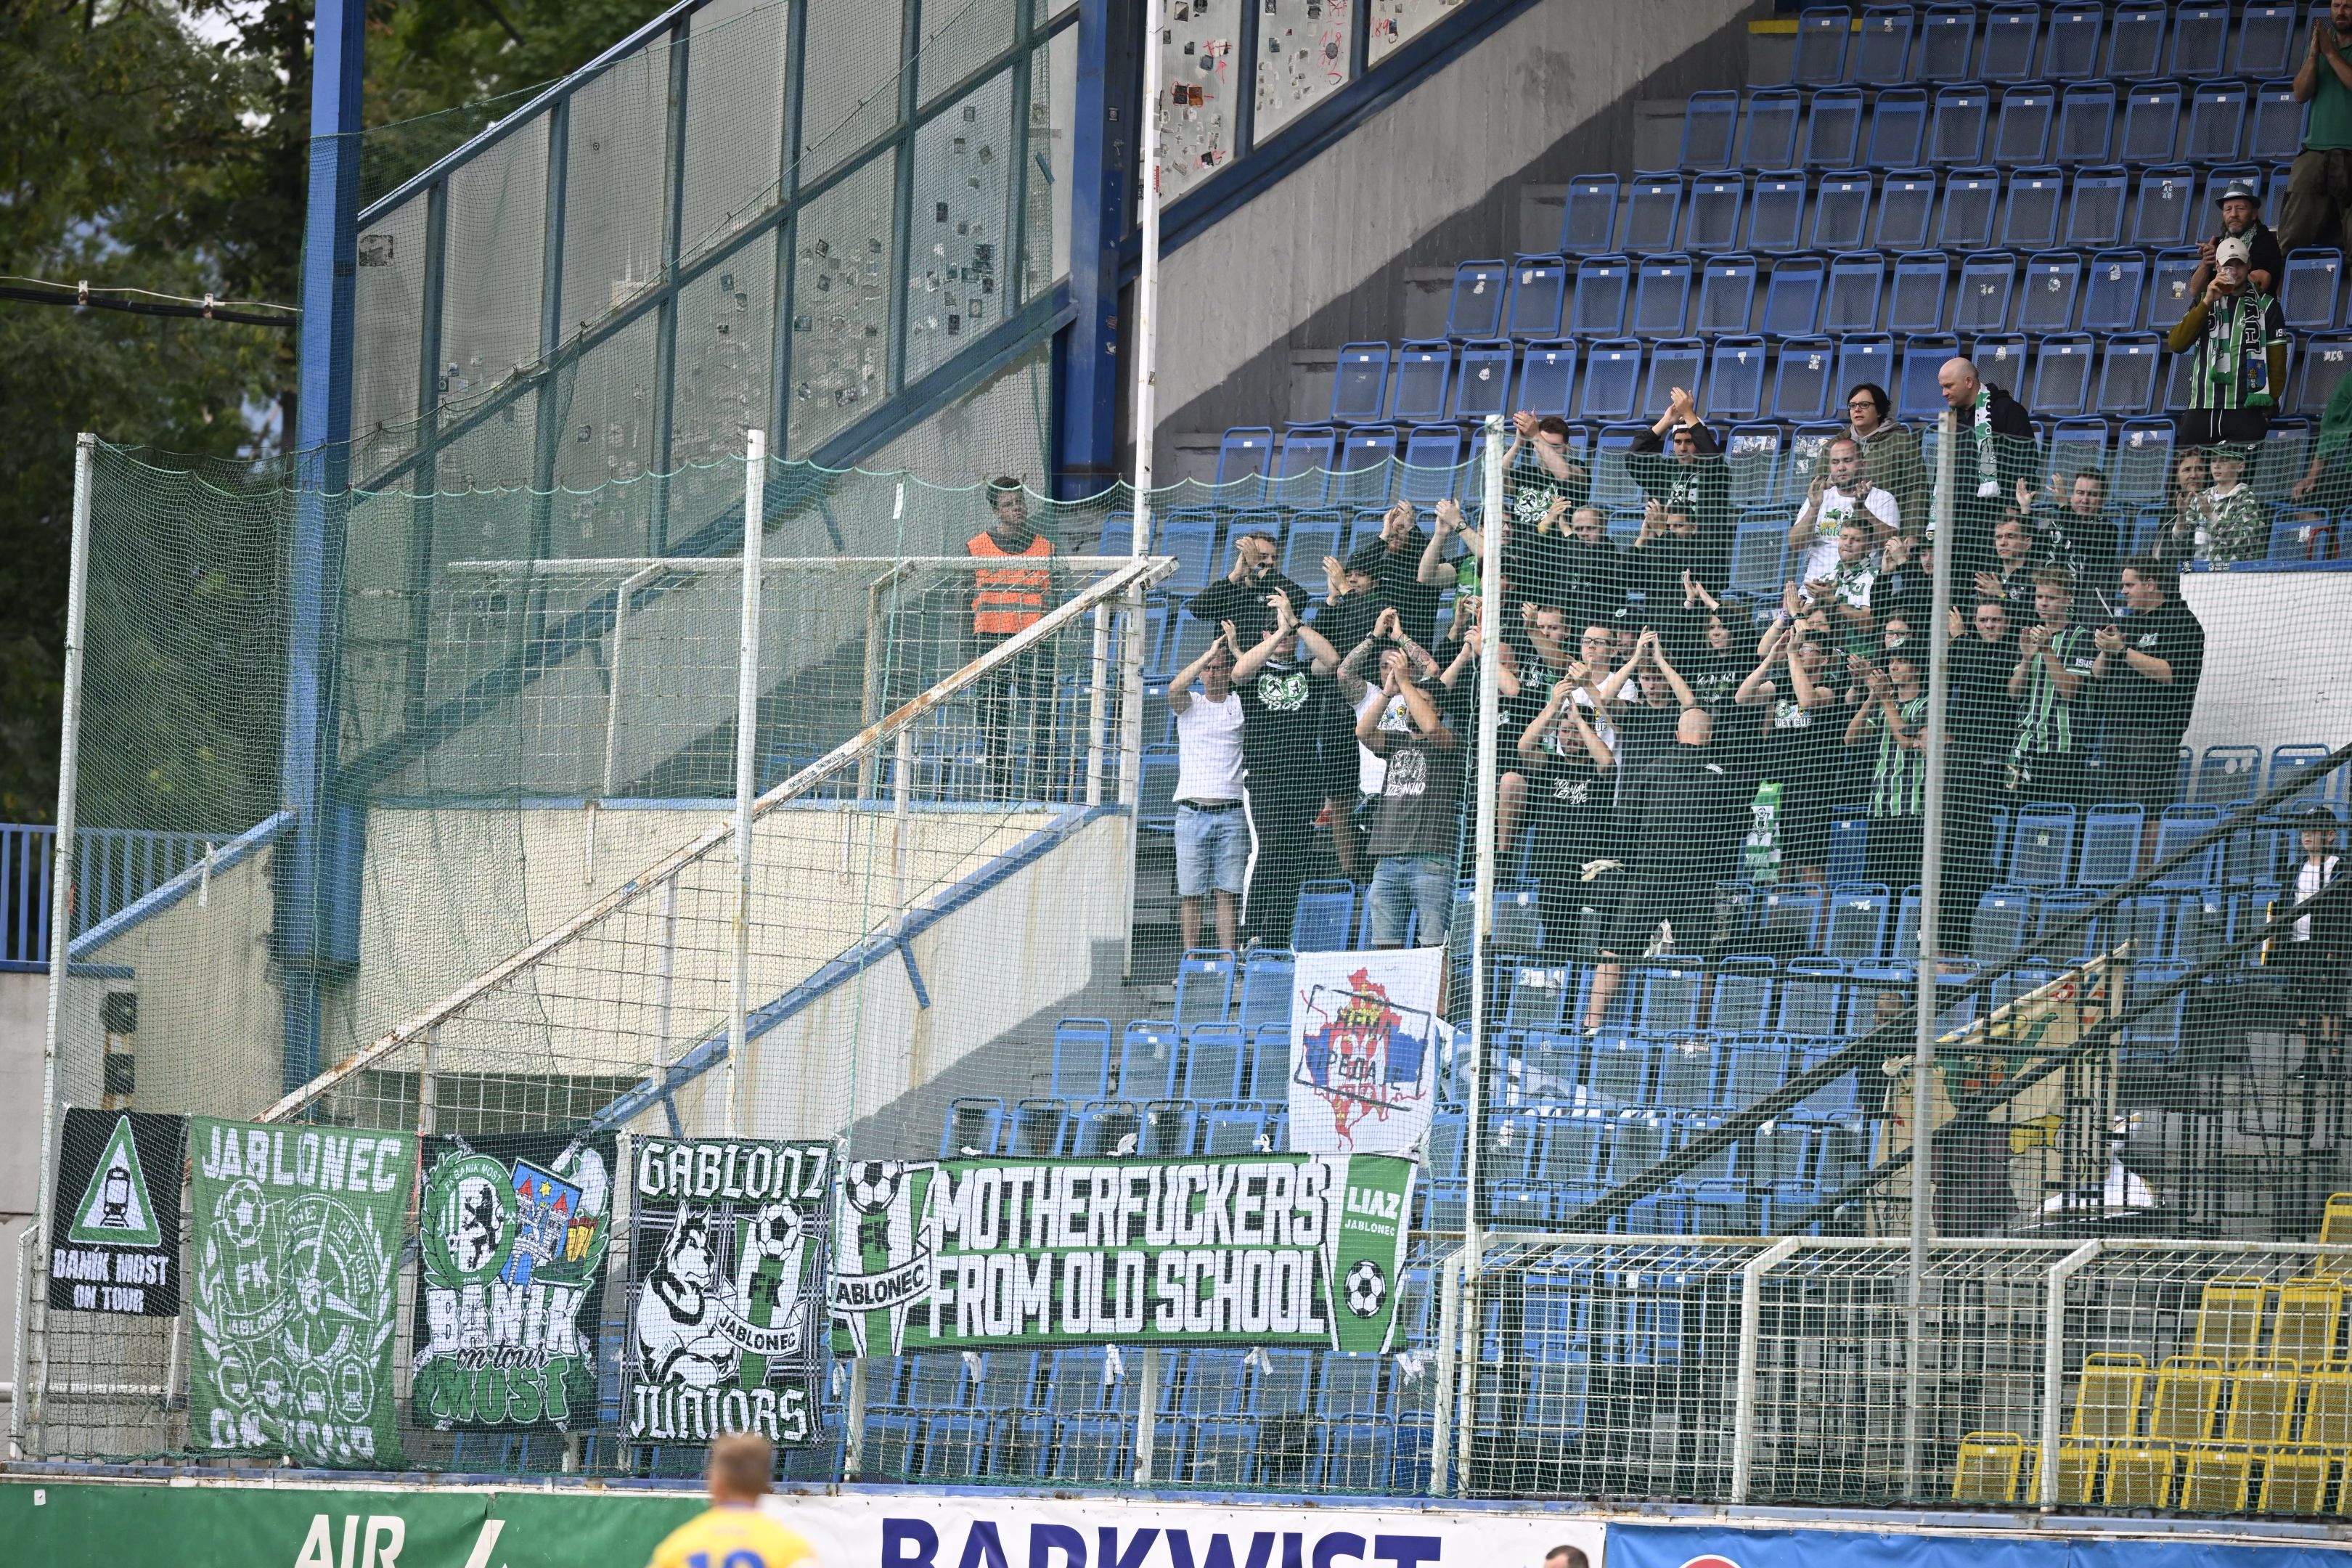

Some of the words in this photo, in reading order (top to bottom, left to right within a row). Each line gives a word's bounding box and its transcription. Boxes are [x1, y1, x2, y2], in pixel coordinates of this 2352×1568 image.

[1267, 701, 1301, 711] 1909
[1792, 717, 1813, 727] CUP
[202, 1126, 401, 1193] JABLONEC
[445, 1178, 455, 1191] FK
[481, 1164, 502, 1184] MOST
[638, 1141, 829, 1199] GABLONZ
[923, 1161, 1328, 1251] MOTHERFUCKERS
[1347, 1186, 1401, 1220] LIAZ
[857, 1220, 893, 1256] FK
[1344, 1220, 1395, 1237] JABLONEC
[115, 1254, 169, 1286] MOST
[235, 1256, 271, 1295] FK
[73, 1284, 97, 1310] ON
[102, 1286, 144, 1313] TOUR
[748, 1272, 784, 1307] FK
[929, 1252, 1048, 1339] FROM
[1062, 1251, 1144, 1334] OLD
[1156, 1249, 1326, 1334] SCHOOL
[717, 1314, 796, 1351] JABLONEC
[457, 1347, 490, 1369] on
[491, 1337, 550, 1369] tour
[431, 1356, 569, 1424] MOST
[629, 1384, 808, 1442] JUNIORS
[294, 1514, 405, 1568] AIR
